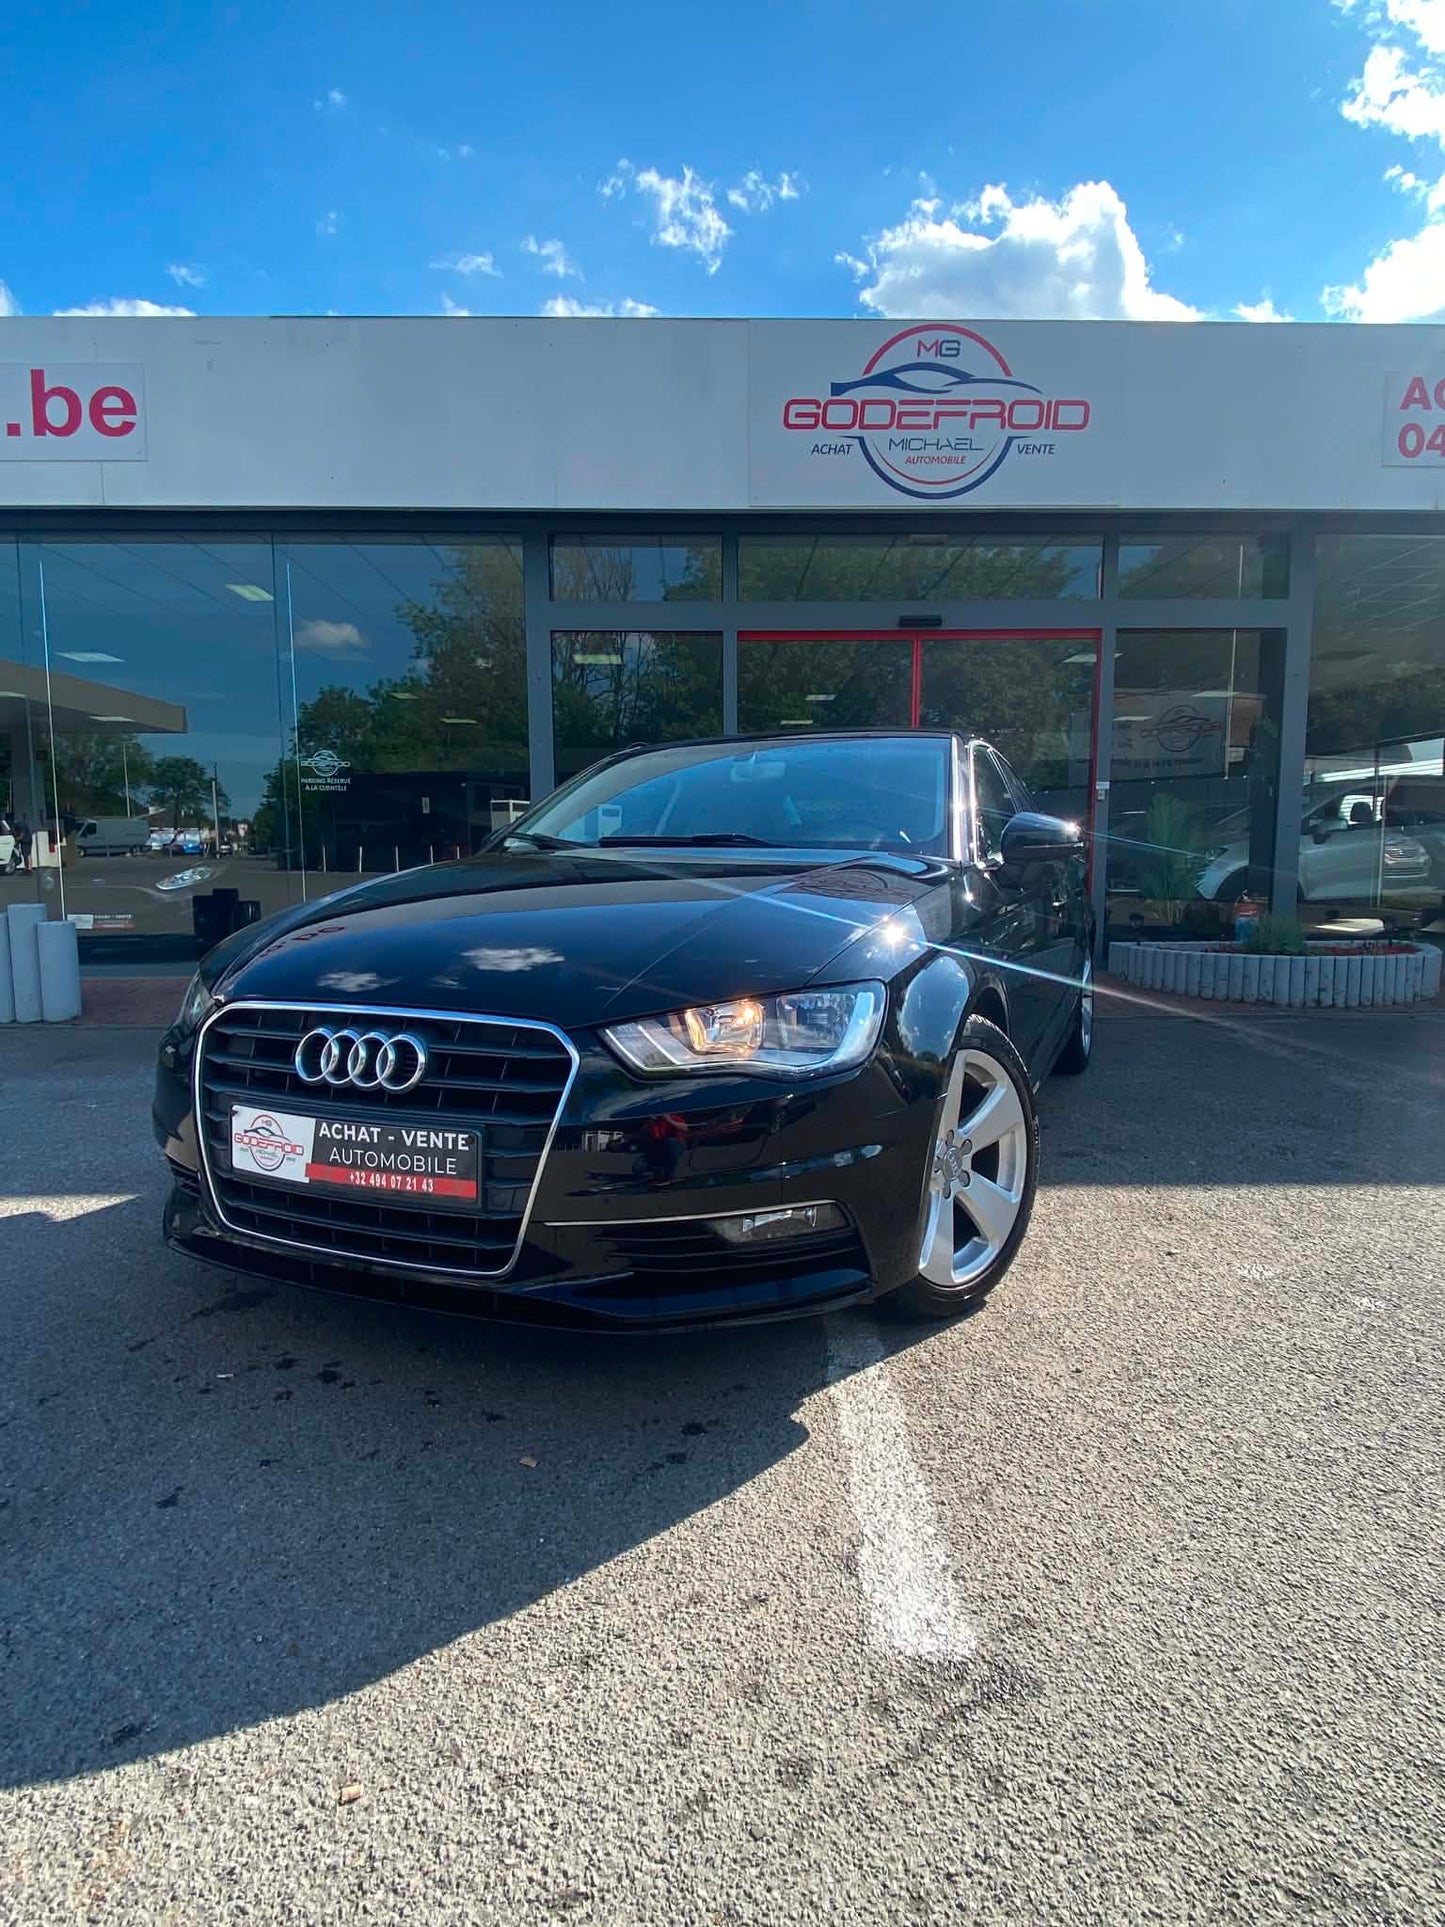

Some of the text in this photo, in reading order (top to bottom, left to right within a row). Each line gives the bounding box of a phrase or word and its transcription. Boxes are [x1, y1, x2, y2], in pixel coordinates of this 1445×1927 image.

[917, 339, 961, 358] MG
[6, 368, 138, 437] .be
[783, 398, 1090, 430] GODEFROID
[811, 443, 854, 455] ACHAT
[888, 437, 984, 451] MICHAEL
[1017, 443, 1055, 455] VENTE
[904, 456, 966, 465] AUTOMOBILE
[319, 1122, 381, 1144] ACHAT
[401, 1129, 470, 1151] VENTE
[329, 1147, 458, 1175] AUTOMOBILE
[350, 1171, 434, 1193] +32 494 07 21 43
